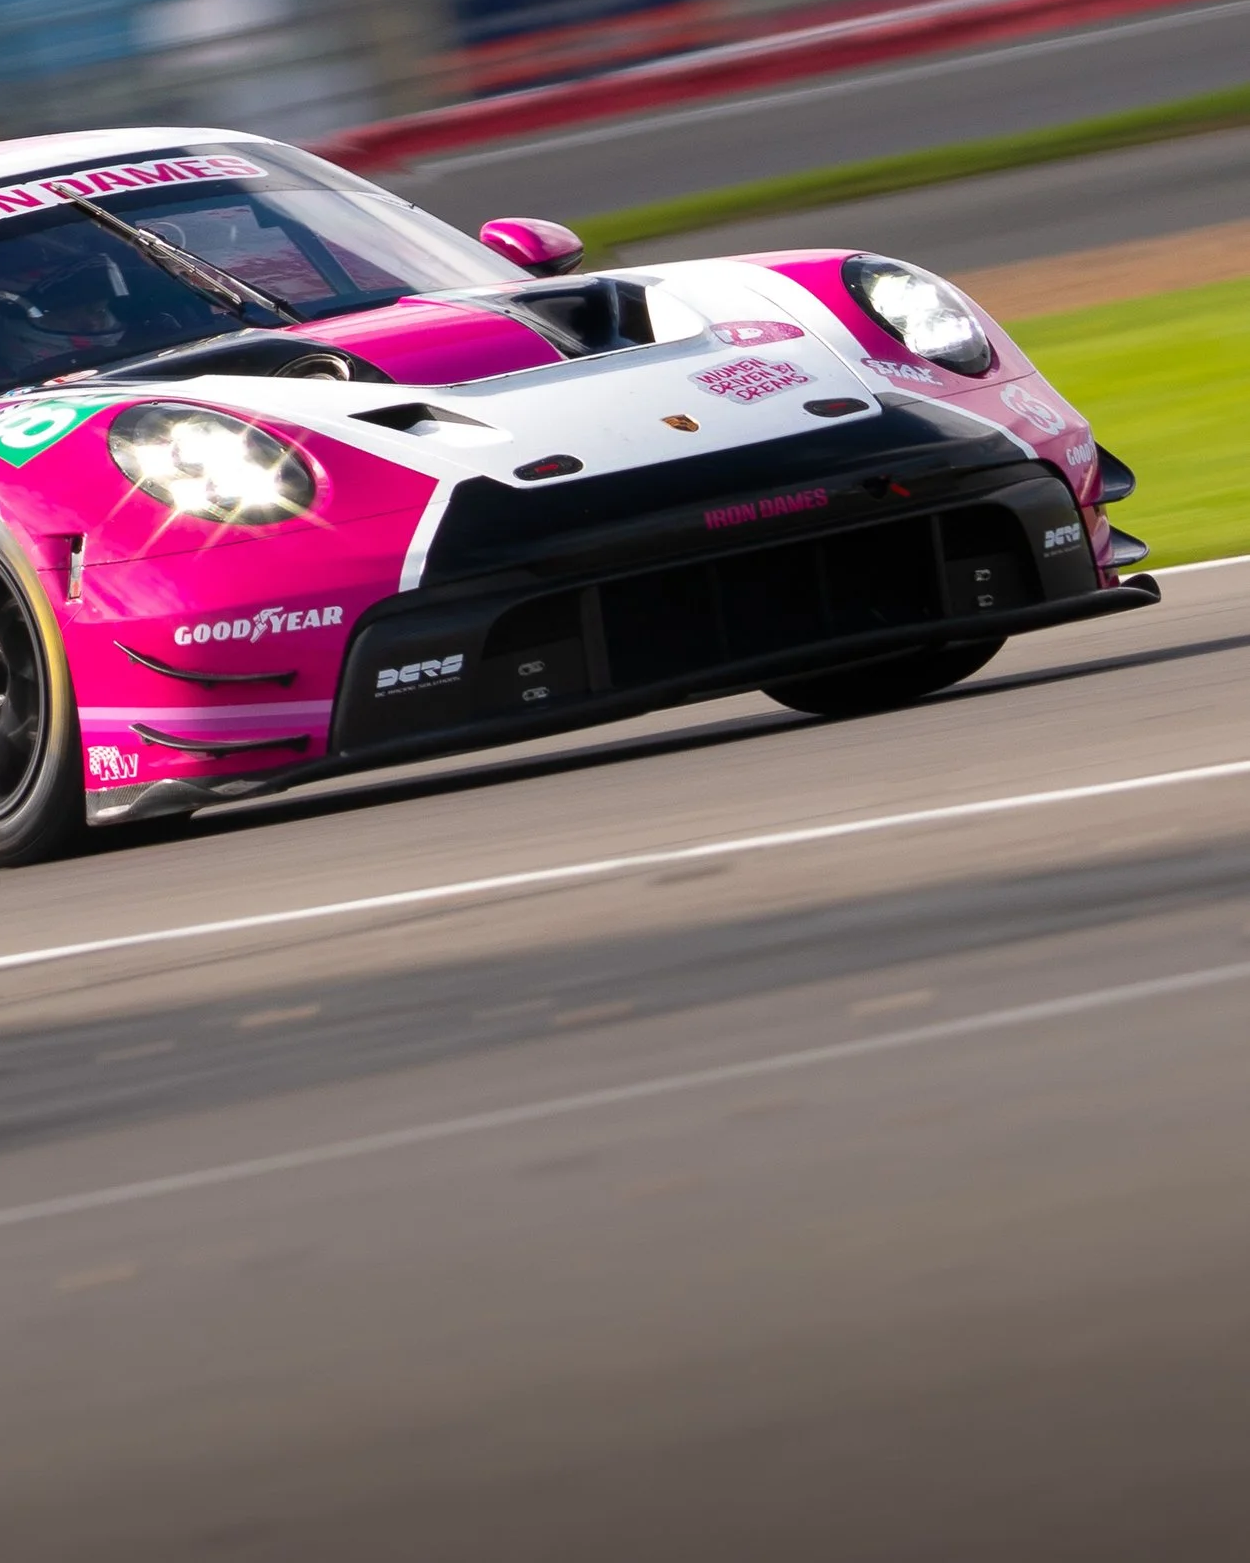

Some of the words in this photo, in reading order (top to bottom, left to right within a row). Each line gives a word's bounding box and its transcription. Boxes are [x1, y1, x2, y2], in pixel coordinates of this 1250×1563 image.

[40, 157, 259, 200] DAMES
[696, 358, 768, 384] WOMEN
[710, 369, 775, 394] DRIVEN
[736, 372, 808, 400] DREAMS
[704, 502, 756, 529] IRON
[759, 487, 828, 518] DAMES
[174, 606, 343, 646] GOODYEAR
[99, 752, 139, 781] KW
